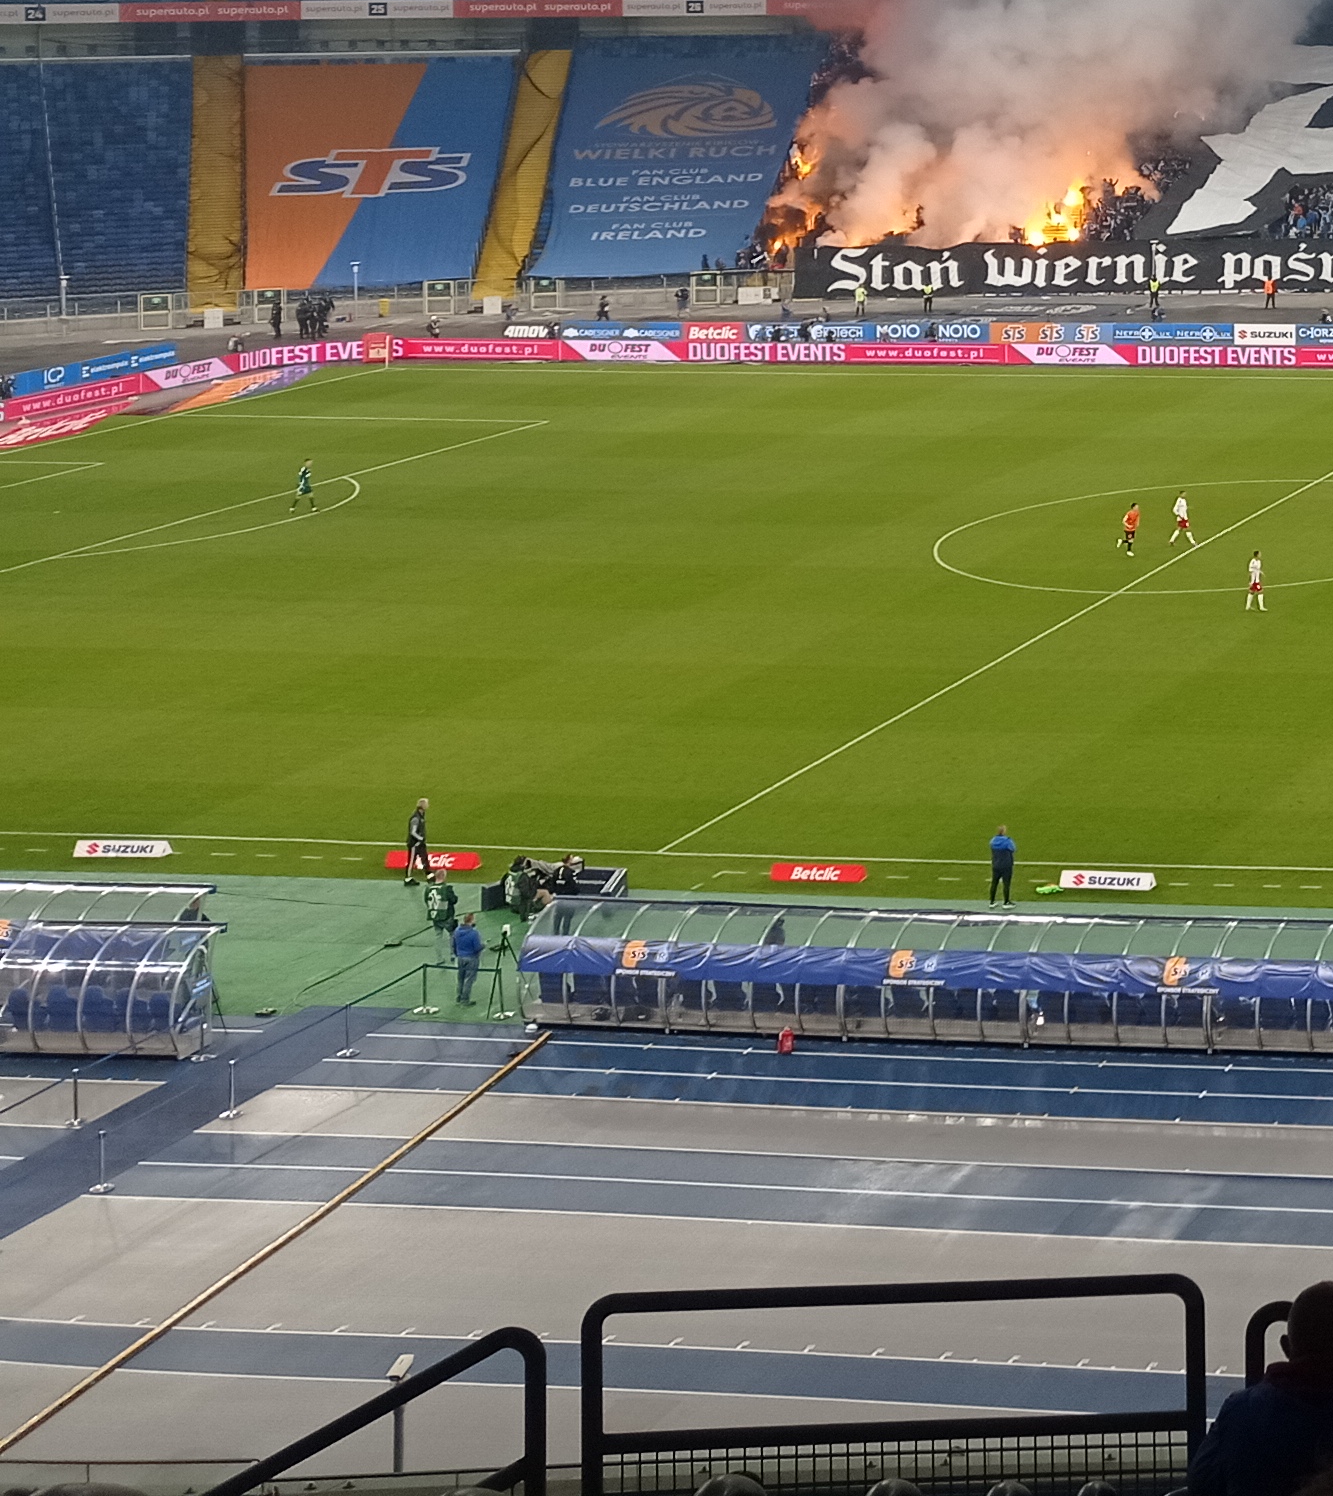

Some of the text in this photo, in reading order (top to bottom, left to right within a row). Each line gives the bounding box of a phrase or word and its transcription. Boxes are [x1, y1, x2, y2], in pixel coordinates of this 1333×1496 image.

[28, 8, 44, 20] 24
[136, 5, 288, 19] superauto.pl superauto.pl
[469, 1, 611, 13] superauto.pl superauto.pl
[573, 144, 777, 160] WIELKI RUCH
[268, 146, 471, 198] STS
[569, 173, 764, 188] BLUE ENGLAND
[568, 200, 750, 214] DEUTSCHLAND
[590, 228, 707, 241] IRELAND
[827, 247, 965, 292] Stań
[983, 244, 1199, 288] wiernie
[504, 325, 557, 338] 4MOV
[689, 326, 739, 340] Betclic
[938, 324, 981, 338] NO10
[1003, 324, 1101, 341] STS STS STS
[1251, 331, 1293, 339] SUZUKI
[240, 340, 404, 371] DUOFEST EVES
[422, 343, 539, 356] www.duofest.pl
[688, 342, 846, 362] DUOFEST EVENTS
[865, 348, 984, 360] www.duofest.pl
[1137, 346, 1297, 365] DUOFEST EVENTS
[22, 382, 123, 412] www.duofest.pl
[101, 844, 154, 853] SUZUKI
[790, 866, 841, 880] Betclic
[1088, 875, 1140, 886] SUZUKI
